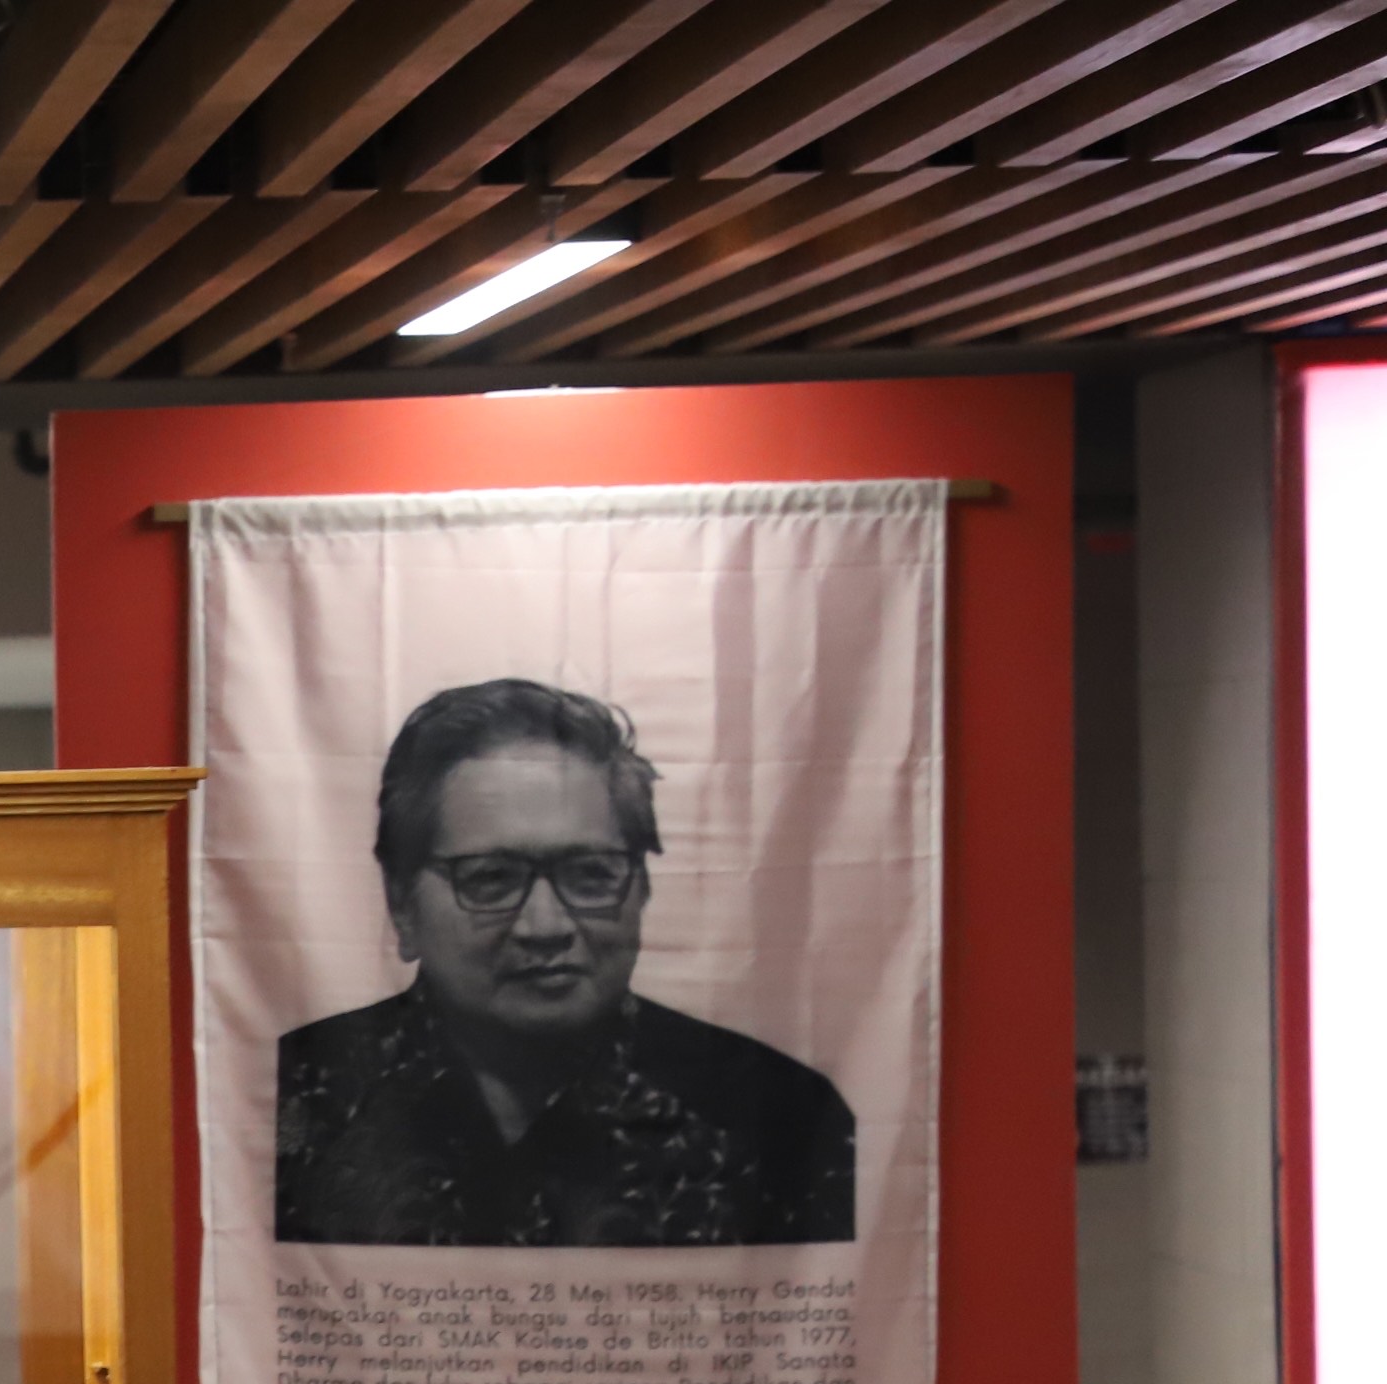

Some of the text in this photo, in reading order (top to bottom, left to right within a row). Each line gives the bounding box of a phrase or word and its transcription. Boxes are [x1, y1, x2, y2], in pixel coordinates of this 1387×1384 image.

[275, 1276, 854, 1307] Lahir di Yogyakarta, 28 Herry Gendut
[417, 1307, 629, 1335] anak bungsu dari
[277, 1324, 856, 1353] Selepas dari SMAK Kolese de Britto tahun 1977,
[276, 1346, 856, 1380] Herry melanjutkan pendidikan di Sanata
